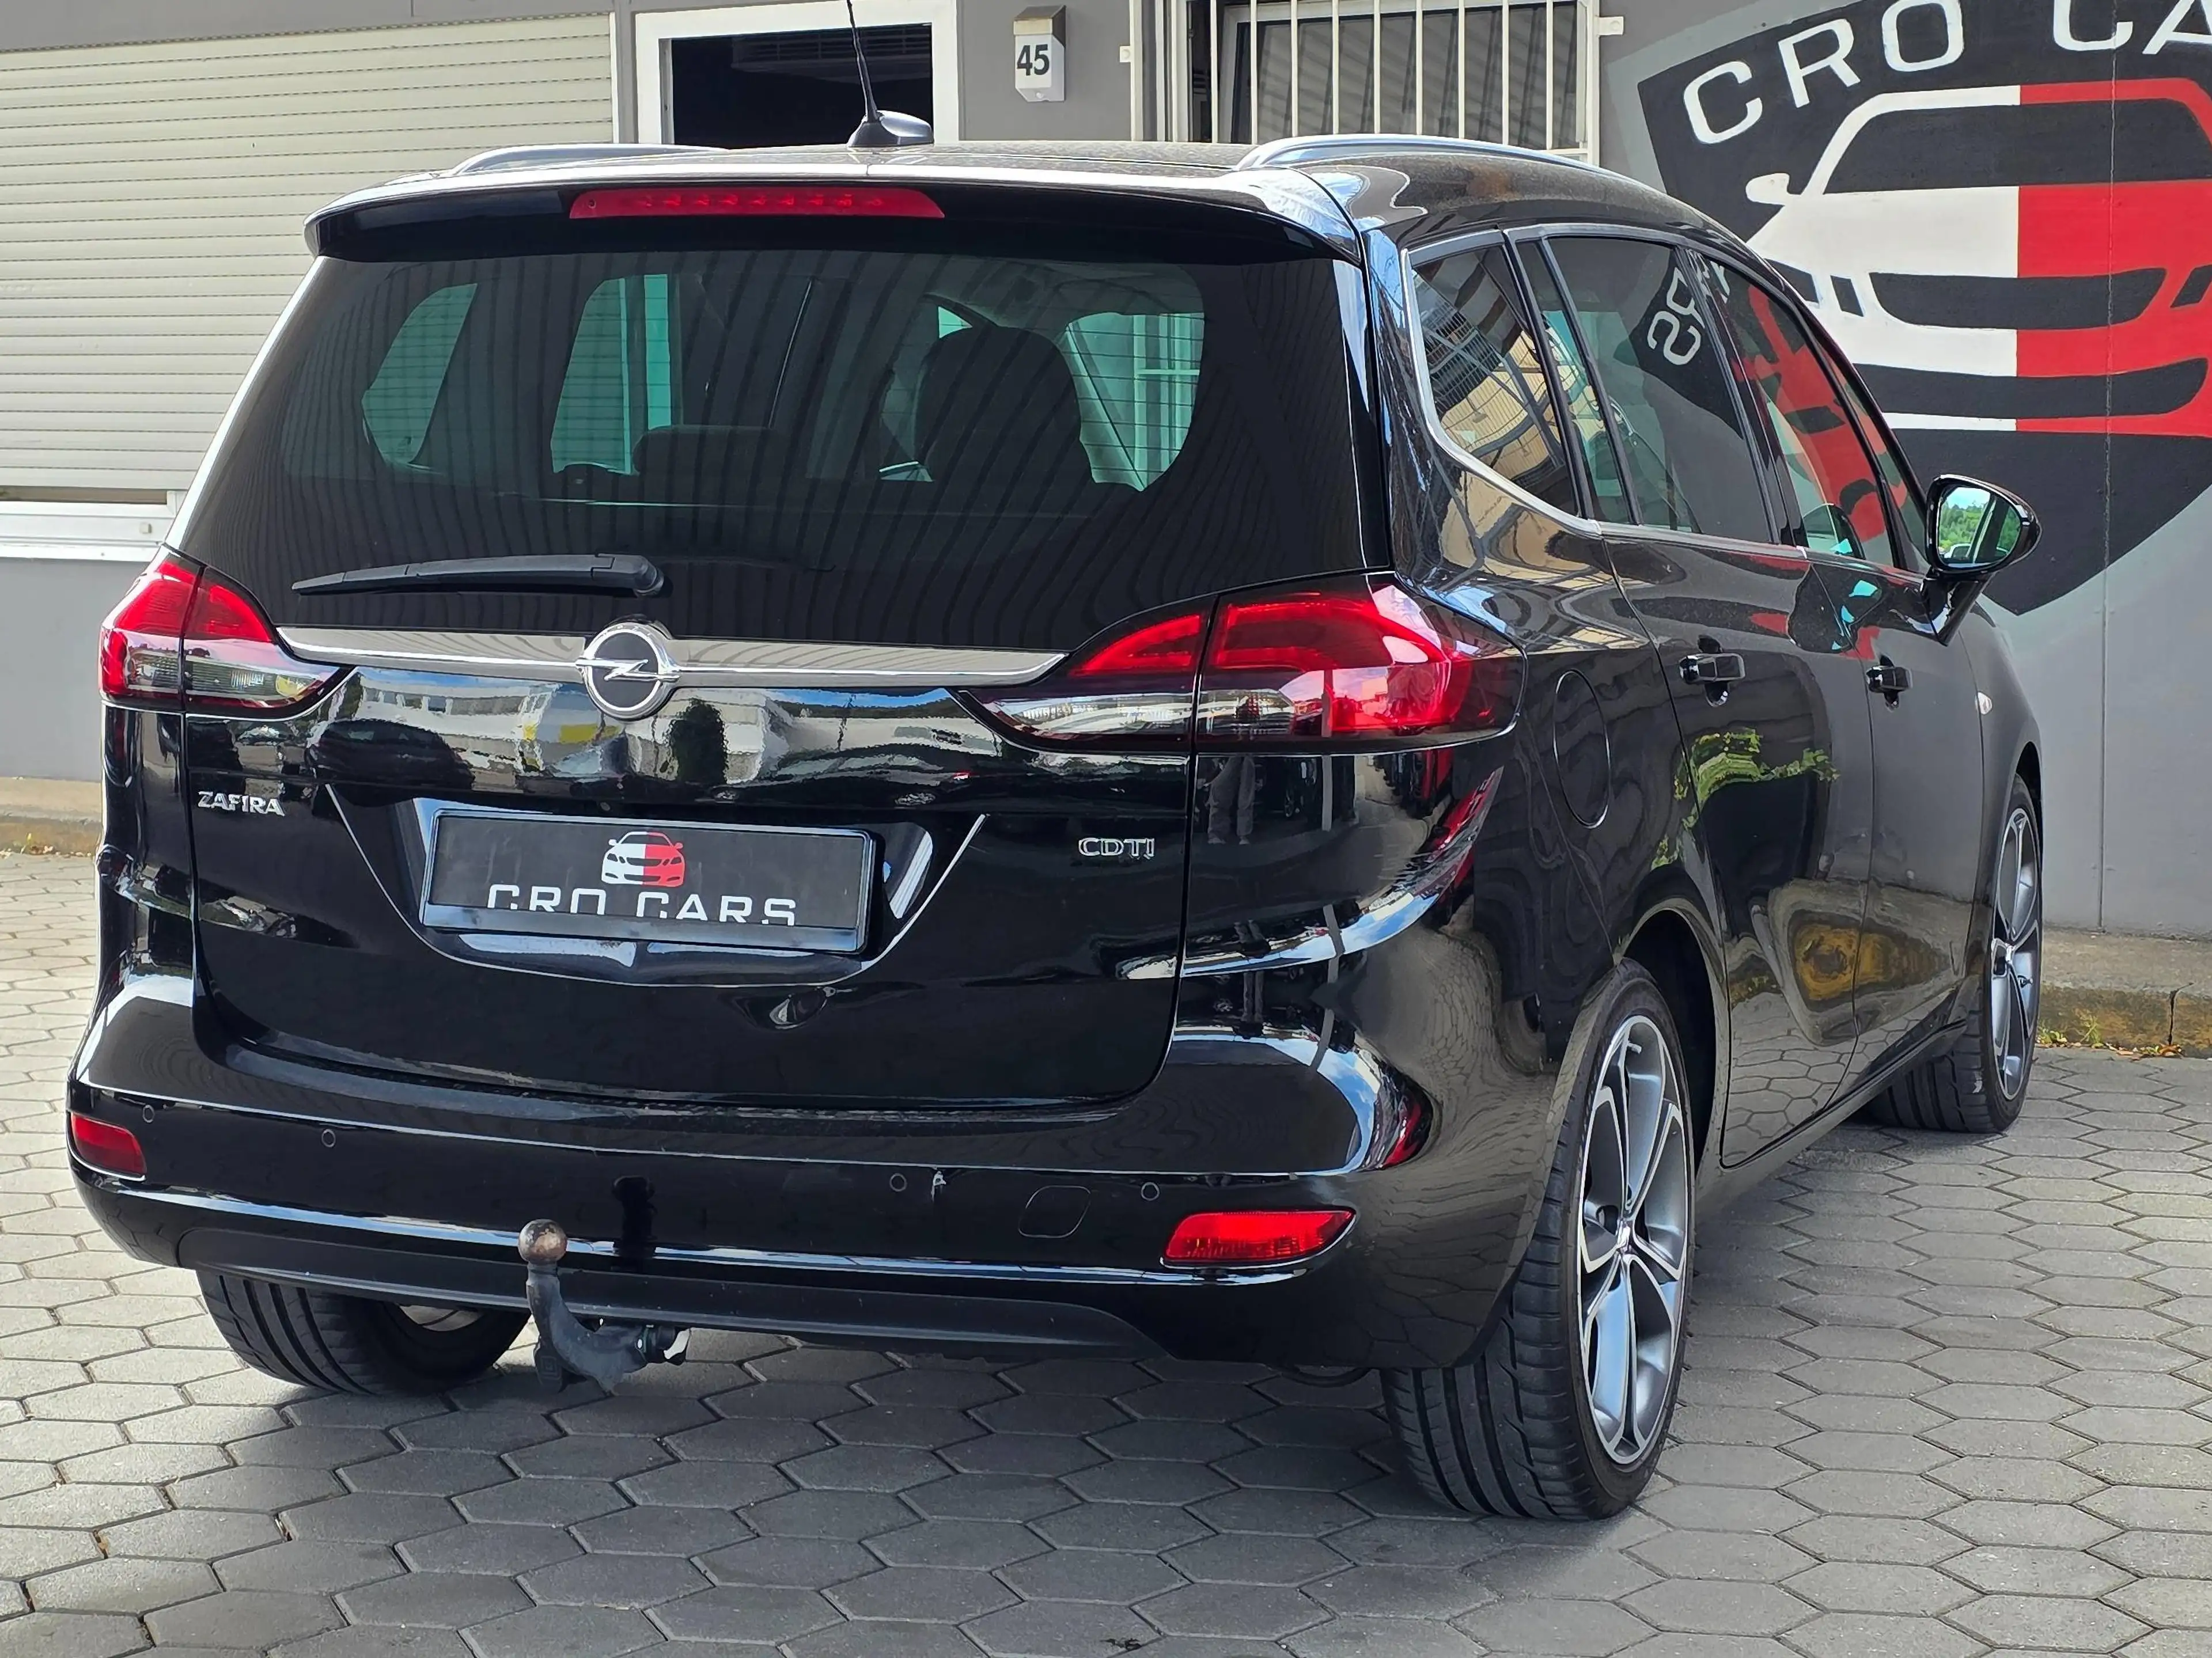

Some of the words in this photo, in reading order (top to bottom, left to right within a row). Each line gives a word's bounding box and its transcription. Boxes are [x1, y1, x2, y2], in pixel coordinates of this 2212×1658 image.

[1017, 44, 1050, 75] 45
[1683, 0, 1964, 144] CRO
[198, 791, 286, 817] ZAFIRA
[1078, 837, 1155, 858] CDTI
[487, 884, 607, 915] CRO
[636, 891, 796, 926] CARS
